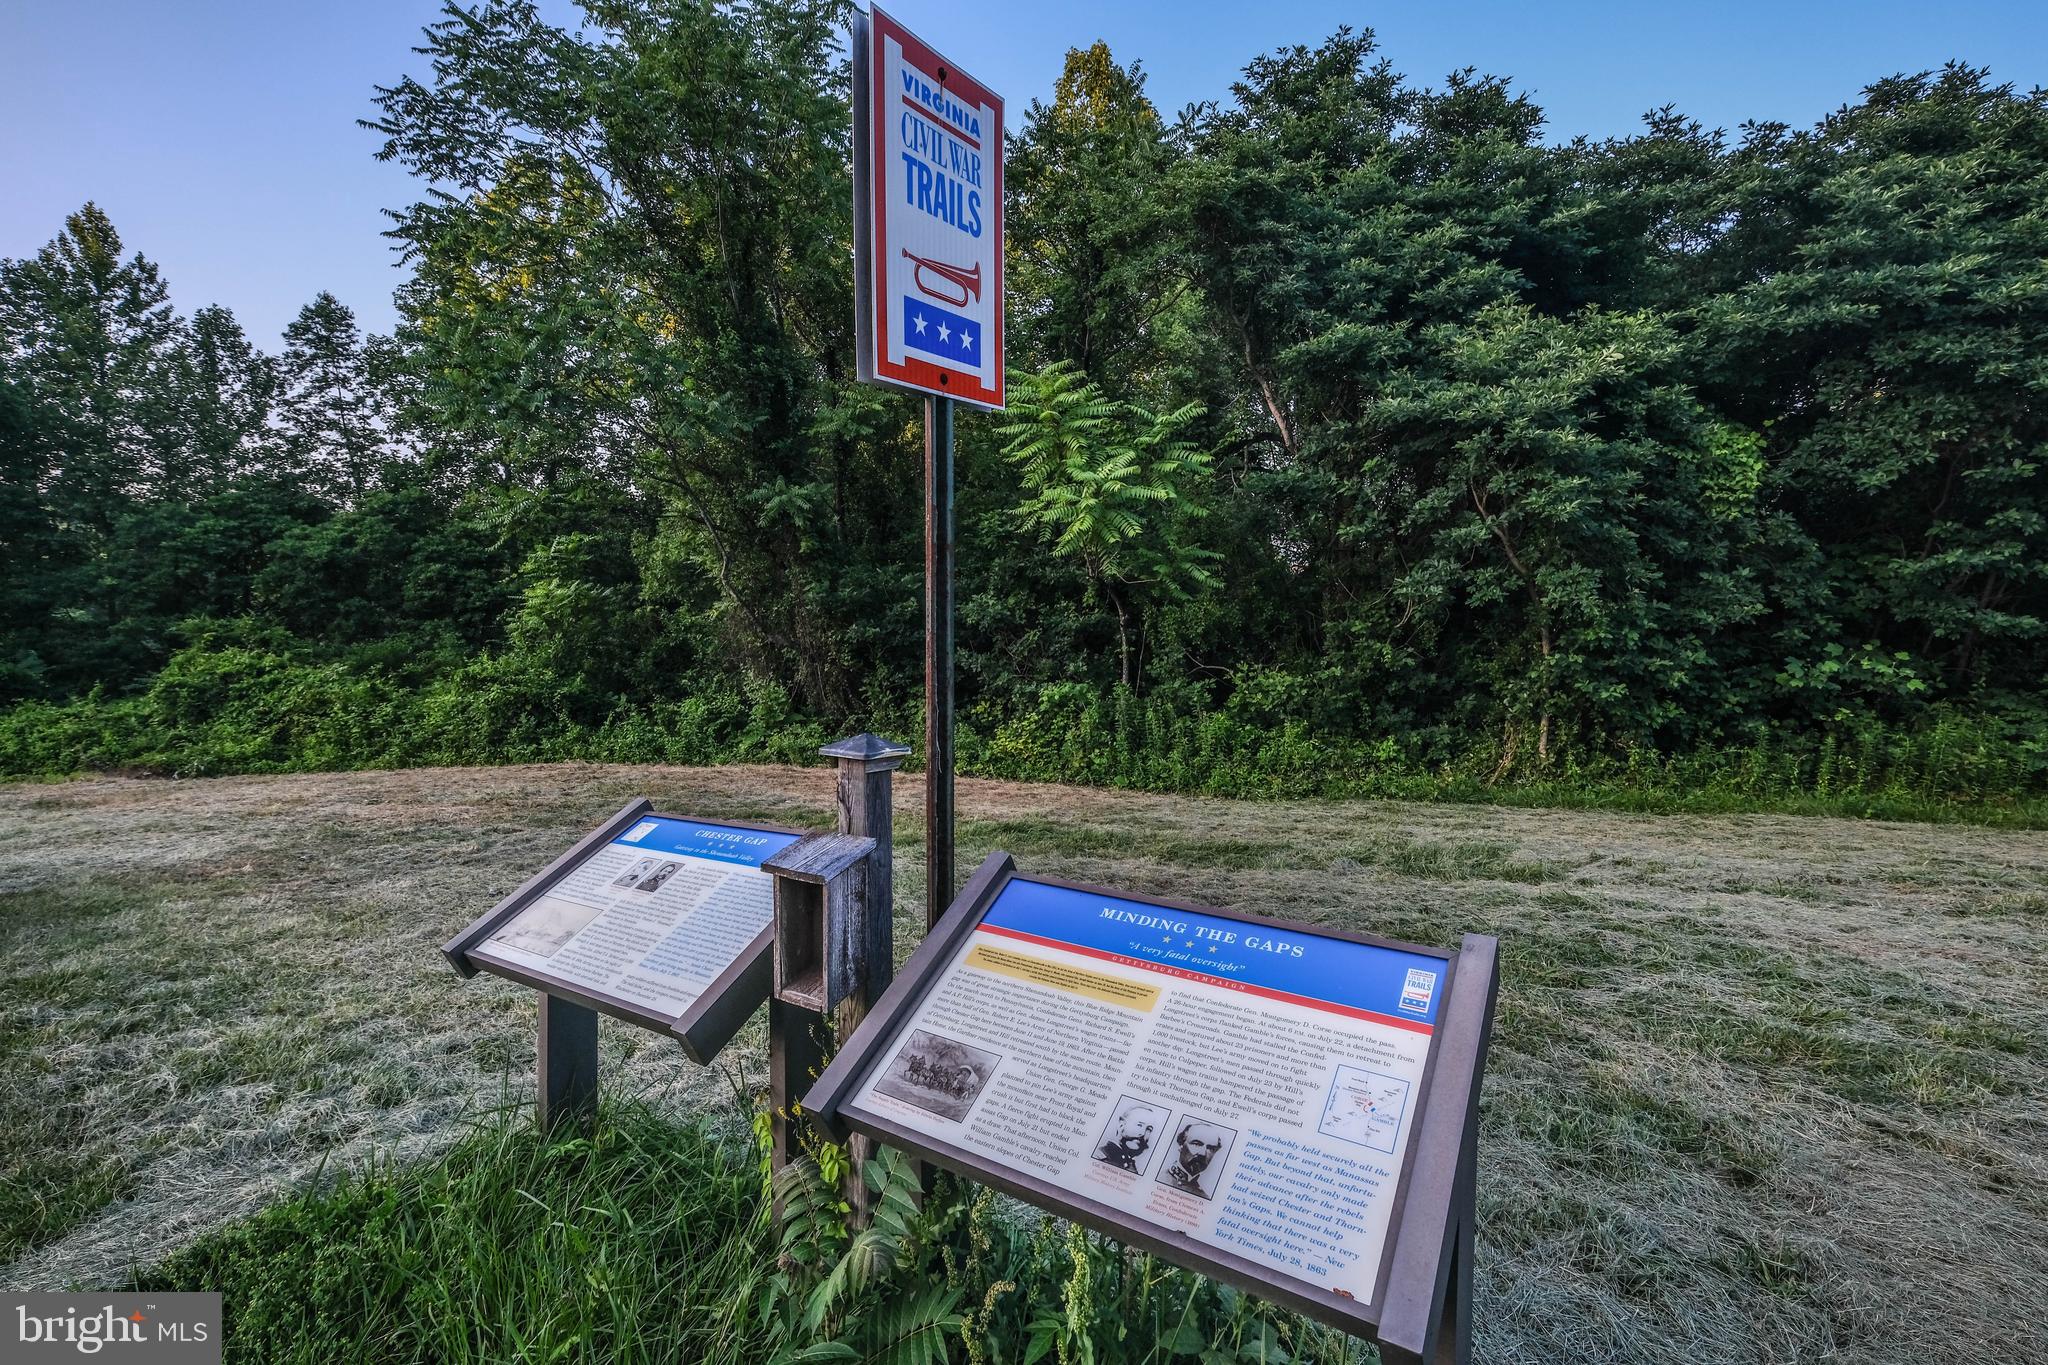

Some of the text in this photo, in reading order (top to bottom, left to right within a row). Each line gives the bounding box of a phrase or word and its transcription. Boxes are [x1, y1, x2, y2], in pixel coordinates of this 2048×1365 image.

[902, 69, 981, 138] VIRGINIA
[901, 112, 982, 189] CIVIL WAR
[902, 152, 982, 239] TRAILS
[695, 830, 768, 846] CHESTER GAP
[1098, 907, 1305, 958] MINDING THE GAPS
[1141, 946, 1163, 956] very
[1163, 949, 1189, 962] fatal
[1111, 956, 1246, 990] GETTYSBURG CAMPAIGN
[1407, 980, 1432, 991] TRAILS
[1146, 1038, 1171, 1048] another
[1240, 1064, 1266, 1074] passed
[1264, 1069, 1294, 1082] through
[1293, 1078, 1320, 1091] quickly
[1151, 1029, 1169, 1038] 1,000
[1198, 1041, 1210, 1049] but
[1228, 1051, 1246, 1060] army
[1247, 1056, 1271, 1065] moved
[1288, 1065, 1308, 1075] fight
[1155, 1022, 1174, 1030] erates
[1186, 1030, 1215, 1041] captured
[1215, 1037, 1234, 1046] about
[1243, 1045, 1275, 1057] prisoners
[1289, 1057, 1309, 1066] more
[1309, 1061, 1328, 1071] than
[1222, 1029, 1249, 1040] Gamble
[1249, 1035, 1263, 1044] had
[1263, 1040, 1286, 1050] stalled
[1299, 1048, 1326, 1060] Confed-
[1134, 1062, 1146, 1070] his
[1145, 1065, 1172, 1080] infantry
[1172, 1074, 1201, 1087] through
[1198, 1081, 1211, 1089] the
[1226, 1089, 1243, 1099] The
[1243, 1094, 1273, 1108] Federals
[1272, 1102, 1287, 1112] did
[1285, 1107, 1300, 1116] not
[1151, 1049, 1169, 1057] route
[1209, 1064, 1237, 1076] followed
[1246, 1074, 1263, 1085] July
[1262, 1078, 1274, 1087] 23
[1272, 1081, 1284, 1091] by
[1176, 1066, 1197, 1075] wagon
[1197, 1071, 1218, 1081] trains
[1219, 1076, 1255, 1092] hampered
[1252, 1087, 1267, 1095] the
[1265, 1091, 1296, 1104] passage
[1125, 1080, 1153, 1093] through
[1151, 1087, 1160, 1095] it
[1158, 1091, 1204, 1108] unchallenged
[1212, 1106, 1229, 1118] July
[1130, 1071, 1142, 1081] try
[1148, 1076, 1167, 1087] block
[1167, 1082, 1199, 1096] Thornton
[1216, 1098, 1231, 1106] and
[1257, 1110, 1278, 1121] corps
[1277, 1116, 1303, 1127] passed
[1244, 1140, 1380, 1186] passes as far west as Manassas
[1261, 1134, 1302, 1151] probably
[1299, 1143, 1321, 1155] held
[1321, 1152, 1359, 1169] securely
[1357, 1163, 1375, 1172] all
[1374, 1167, 1390, 1177] the
[1263, 1156, 1282, 1167] But
[1281, 1162, 1315, 1178] beyond
[1336, 1181, 1375, 1196] unfortu-
[1230, 1181, 1366, 1232] had seized Chester and Thorn-
[1234, 1171, 1364, 1219] their advance after the rebels
[1267, 1171, 1285, 1180] our
[1284, 1176, 1320, 1194] cavalry
[1319, 1188, 1341, 1201] only
[1340, 1195, 1368, 1208] made
[1221, 1204, 1360, 1261] thinking that there was a very
[1223, 1192, 1249, 1206] ton's
[1274, 1209, 1288, 1220] We
[1288, 1216, 1322, 1231] cannot
[1322, 1226, 1344, 1242] help
[1212, 1227, 1236, 1241] York
[1266, 1247, 1289, 1263] July
[1305, 1261, 1328, 1275] 1863
[1216, 1215, 1243, 1229] fatal
[1239, 1225, 1283, 1245] oversight
[1324, 1254, 1346, 1268] New
